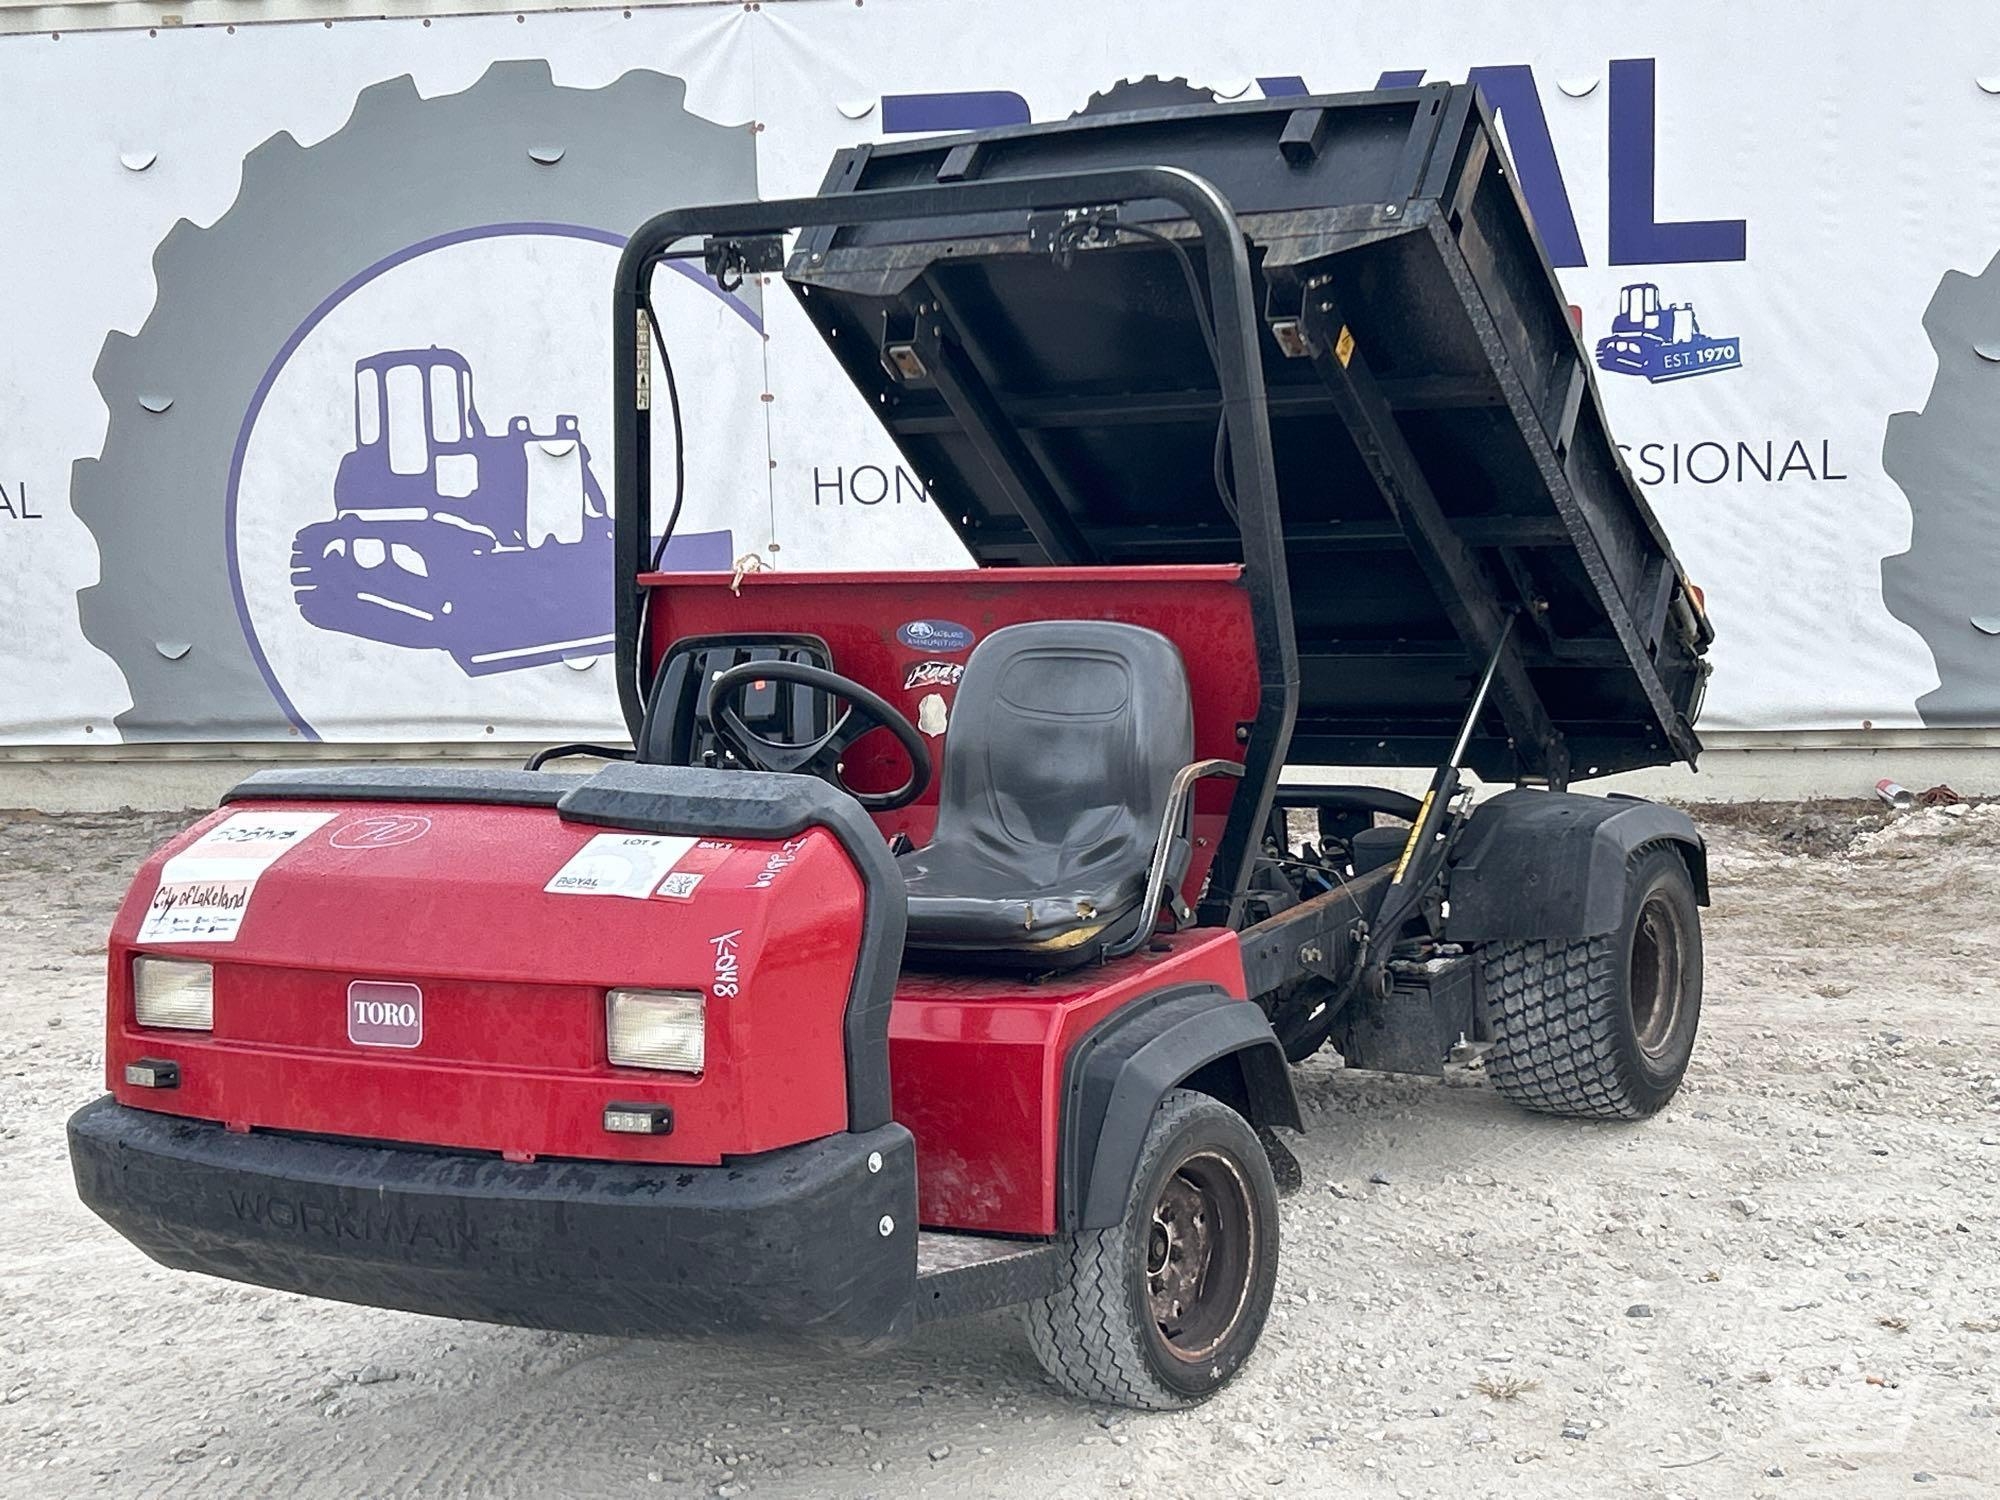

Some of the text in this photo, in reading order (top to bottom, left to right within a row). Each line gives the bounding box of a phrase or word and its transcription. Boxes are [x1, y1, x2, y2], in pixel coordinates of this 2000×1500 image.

[1664, 345, 1735, 369] EST. 1970
[179, 885, 196, 906] of
[354, 1001, 416, 1027] TORO
[228, 1189, 481, 1252] WORKMAN
